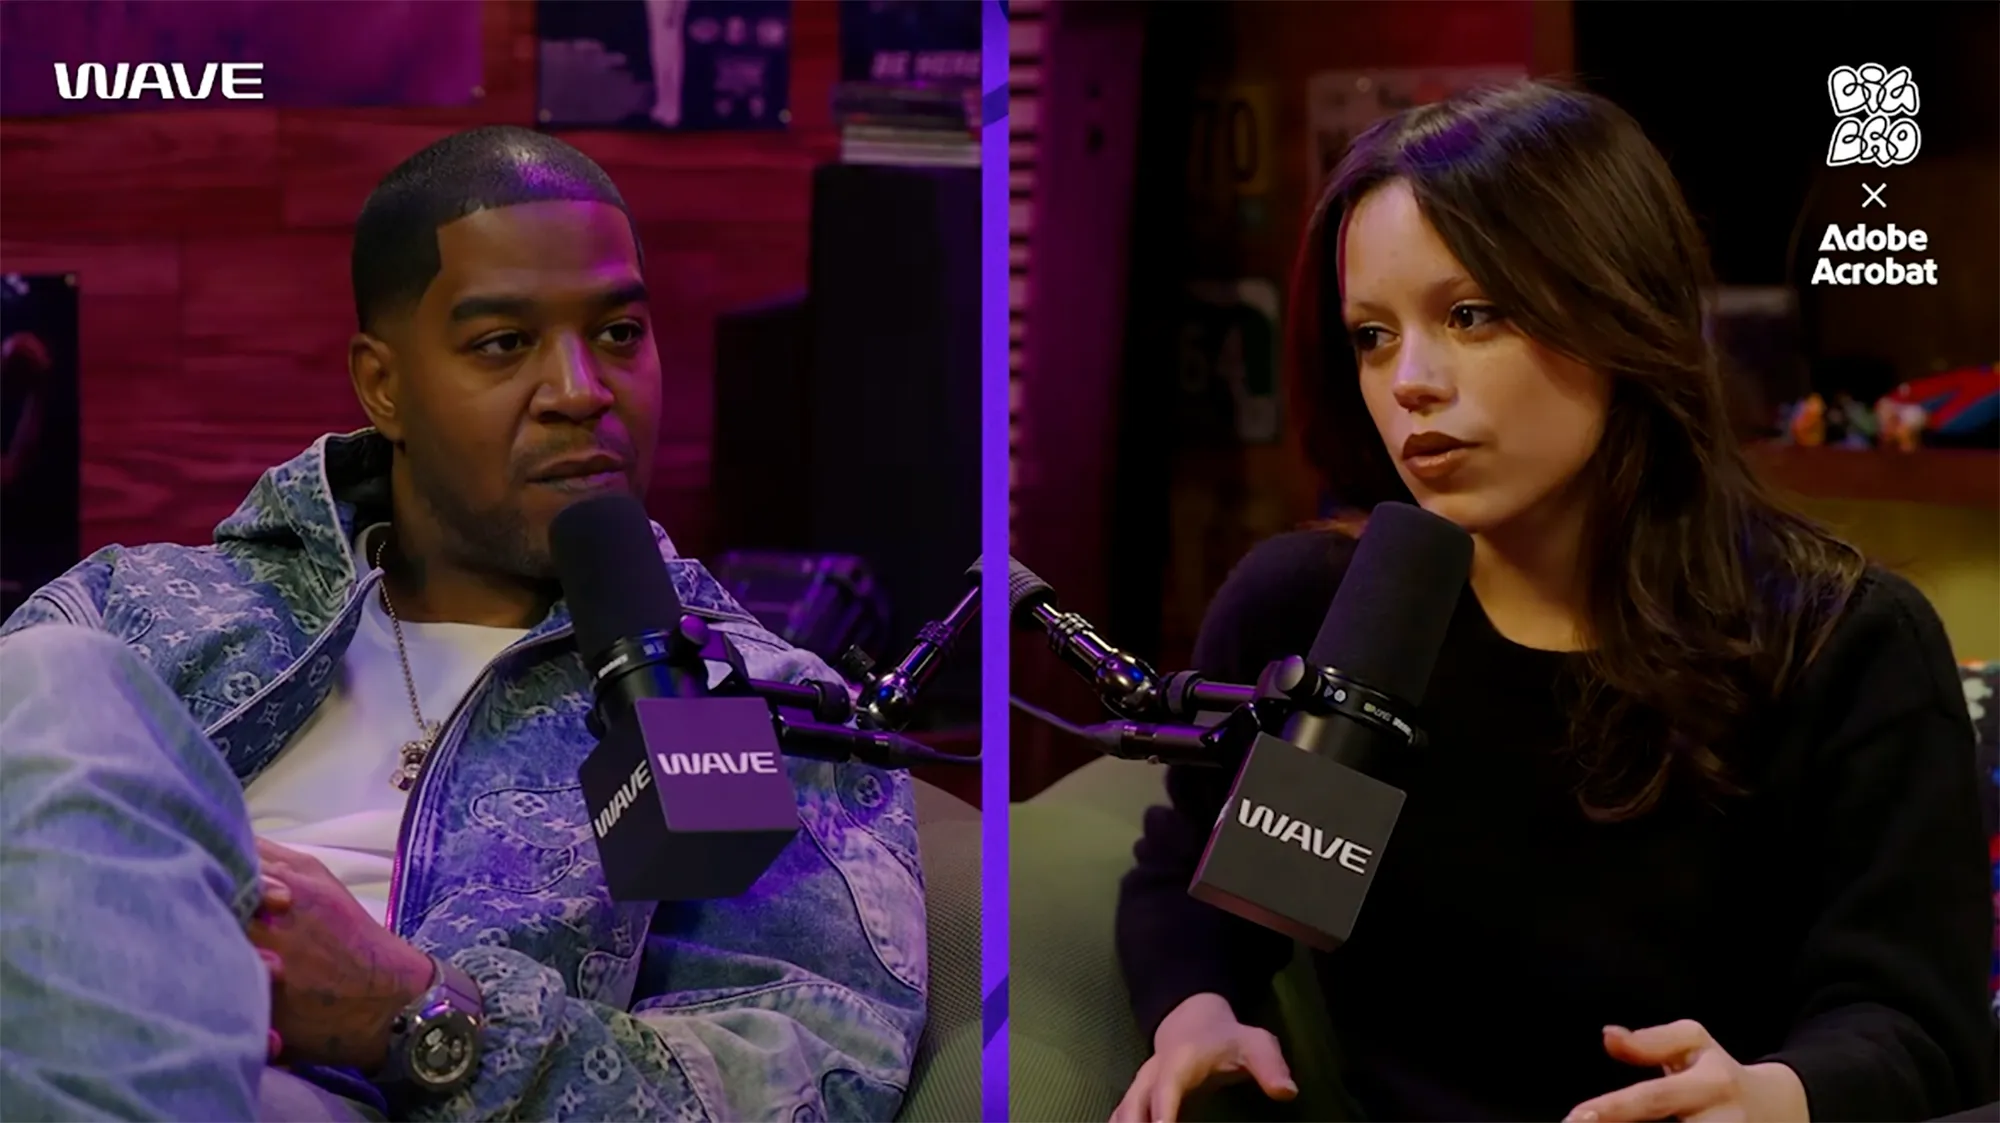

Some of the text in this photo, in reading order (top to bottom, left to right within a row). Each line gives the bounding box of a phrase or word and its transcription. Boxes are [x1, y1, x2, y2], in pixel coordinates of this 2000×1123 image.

[594, 759, 651, 838] WAVE
[657, 752, 778, 775] WAVE
[1238, 798, 1373, 874] WAVE
